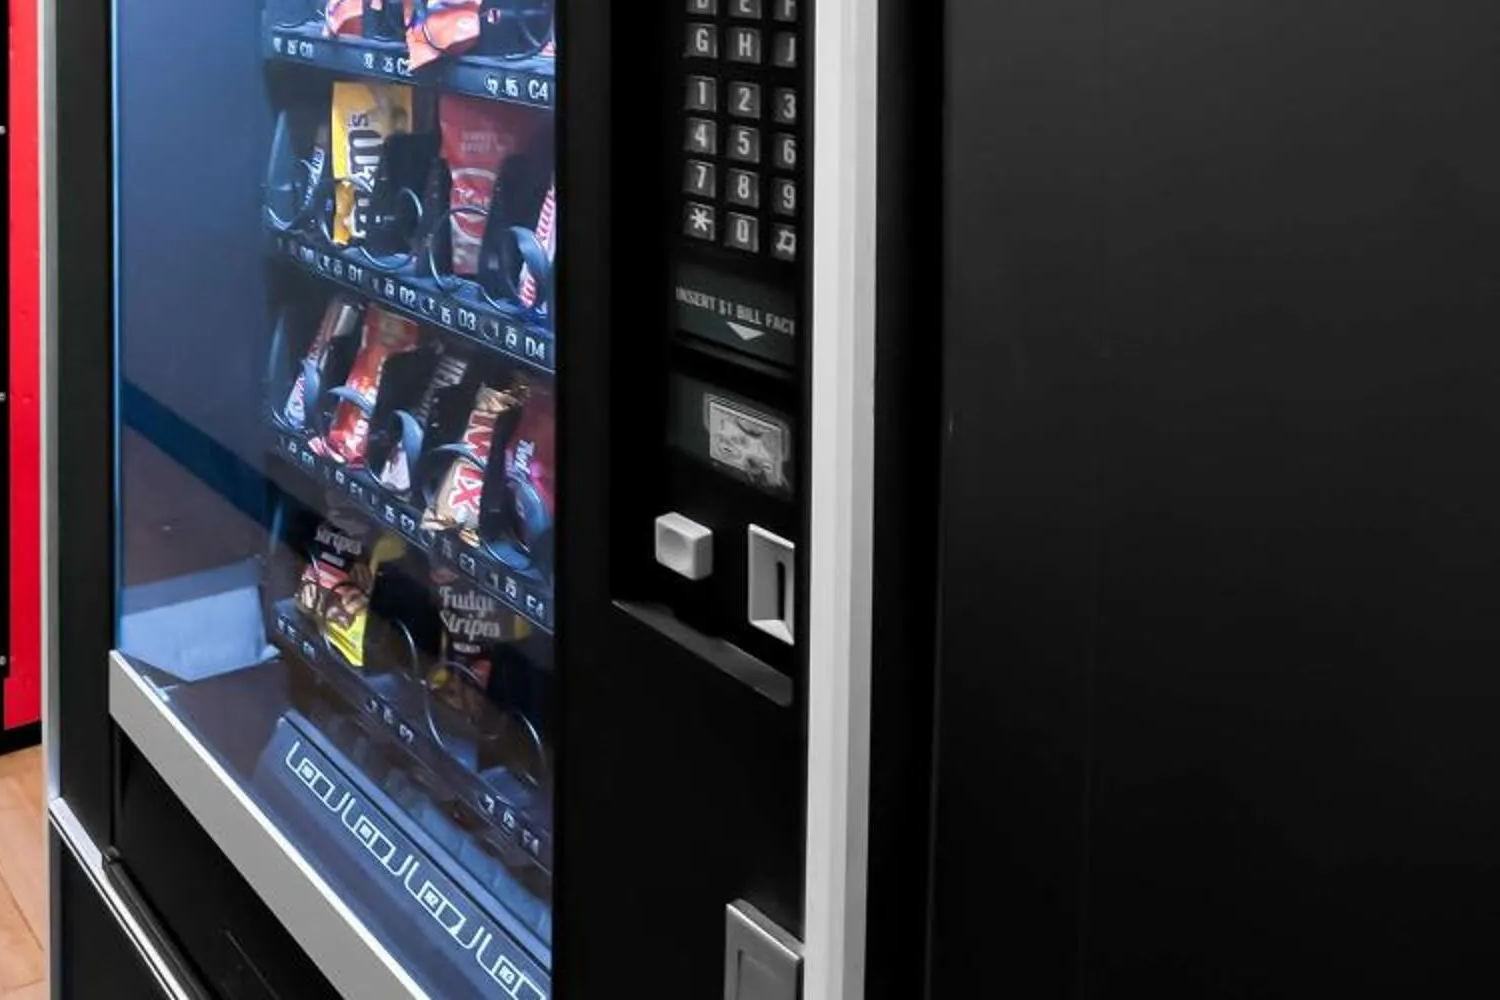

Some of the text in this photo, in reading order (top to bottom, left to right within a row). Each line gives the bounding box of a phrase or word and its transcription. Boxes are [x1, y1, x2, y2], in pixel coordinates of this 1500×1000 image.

[695, 27, 709, 52] G
[739, 32, 752, 57] H
[528, 79, 549, 101] C4
[698, 81, 796, 119] 1 2 3
[694, 123, 796, 164] 4 5 6
[696, 165, 796, 209] 7 8 9
[400, 285, 416, 306] D2
[676, 286, 715, 311] INSERT
[736, 304, 763, 325] BILL
[458, 307, 476, 330] D3
[525, 336, 545, 360] D4
